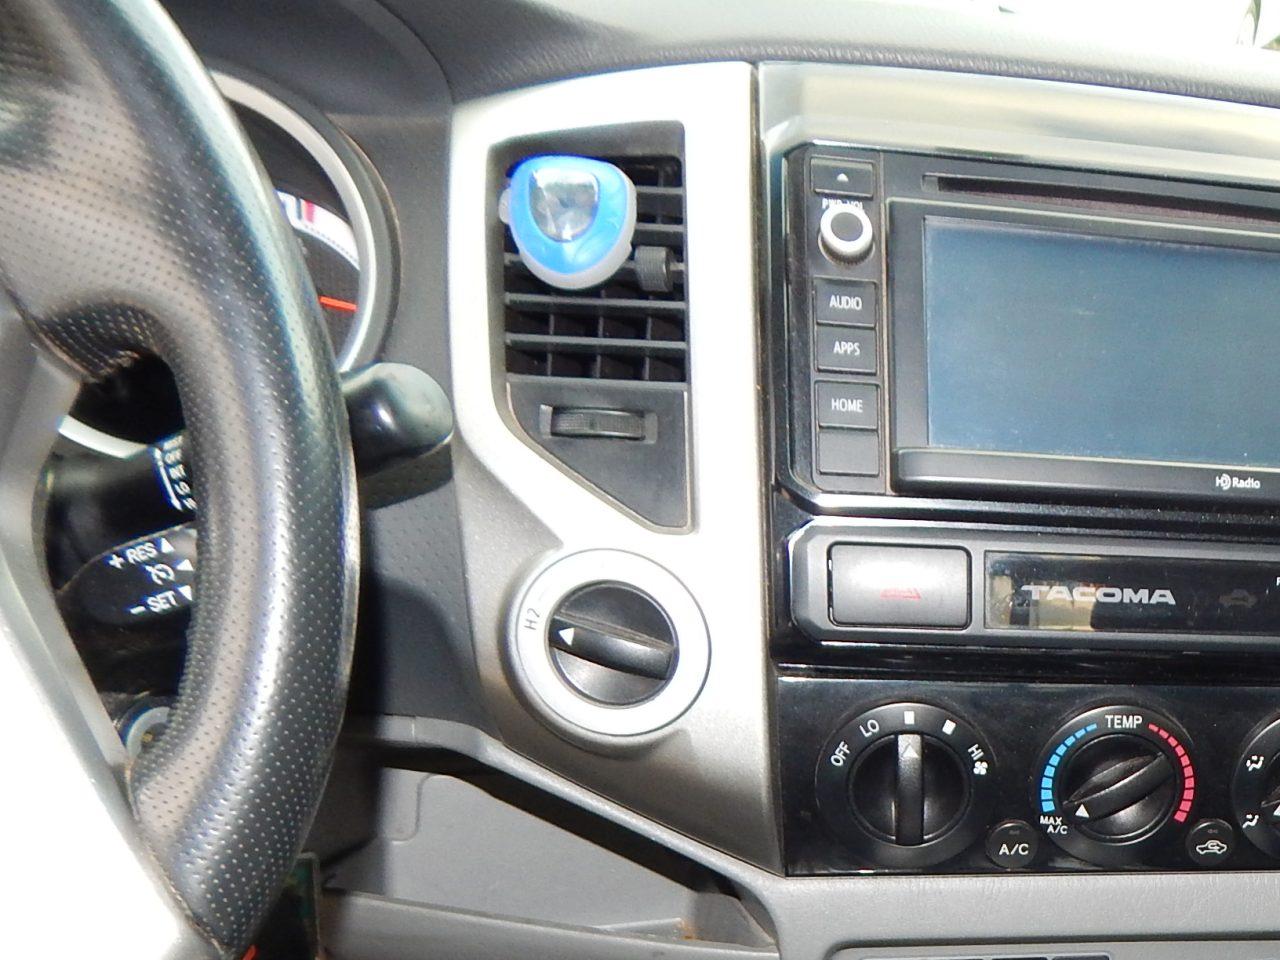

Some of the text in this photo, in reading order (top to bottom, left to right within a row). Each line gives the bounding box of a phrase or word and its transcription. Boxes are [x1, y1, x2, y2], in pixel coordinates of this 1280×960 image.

[829, 296, 862, 310] AUDIO
[833, 341, 861, 356] APPS
[831, 398, 863, 413] HOME
[1232, 477, 1261, 489] Radio
[125, 542, 158, 565] RES
[147, 590, 178, 613] SET
[1021, 584, 1176, 606] TACOMA
[859, 719, 881, 738] LO
[1105, 715, 1142, 728] TEMP
[830, 741, 851, 767] OFF
[967, 743, 985, 761] HI
[1040, 815, 1062, 826] MAX
[1047, 824, 1068, 835] A/C
[999, 843, 1029, 856] A/C
